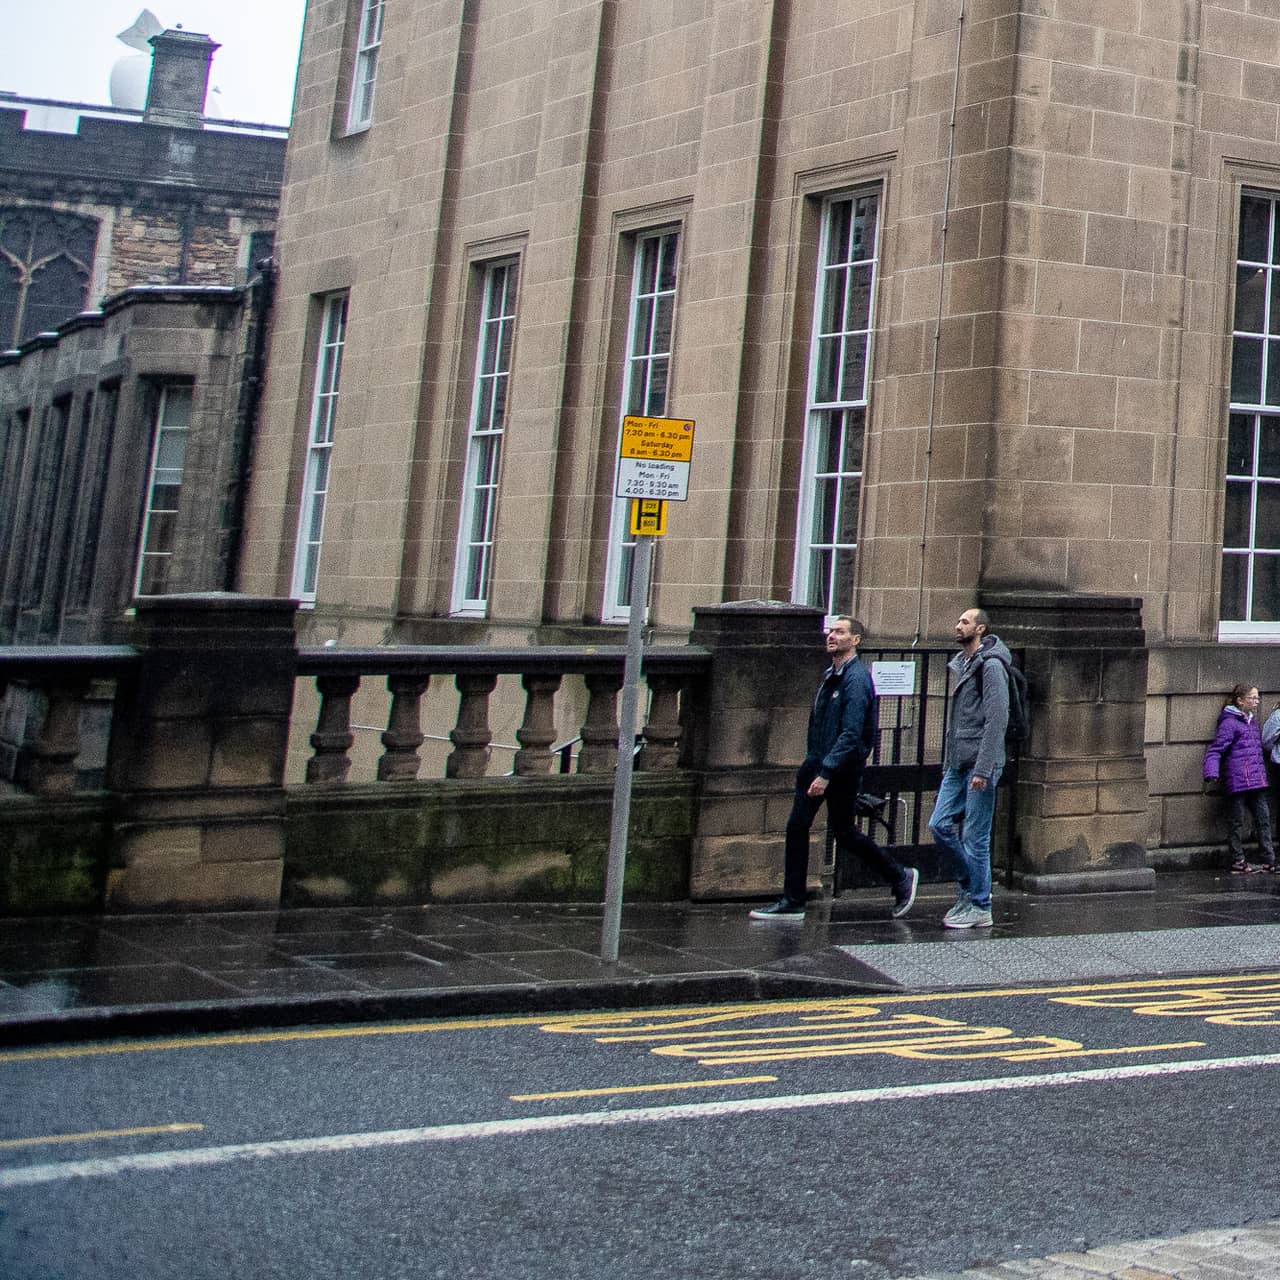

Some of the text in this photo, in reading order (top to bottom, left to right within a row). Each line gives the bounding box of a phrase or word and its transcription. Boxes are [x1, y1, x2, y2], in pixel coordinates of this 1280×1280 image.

[625, 429, 643, 437] 7.30
[660, 431, 678, 439] 6.30
[641, 440, 673, 449] Saturday
[652, 449, 671, 457] 6.30
[648, 462, 675, 471] loading
[626, 479, 644, 487] 7.30
[625, 487, 644, 495] 4.00
[538, 1004, 1085, 1066] STOP
